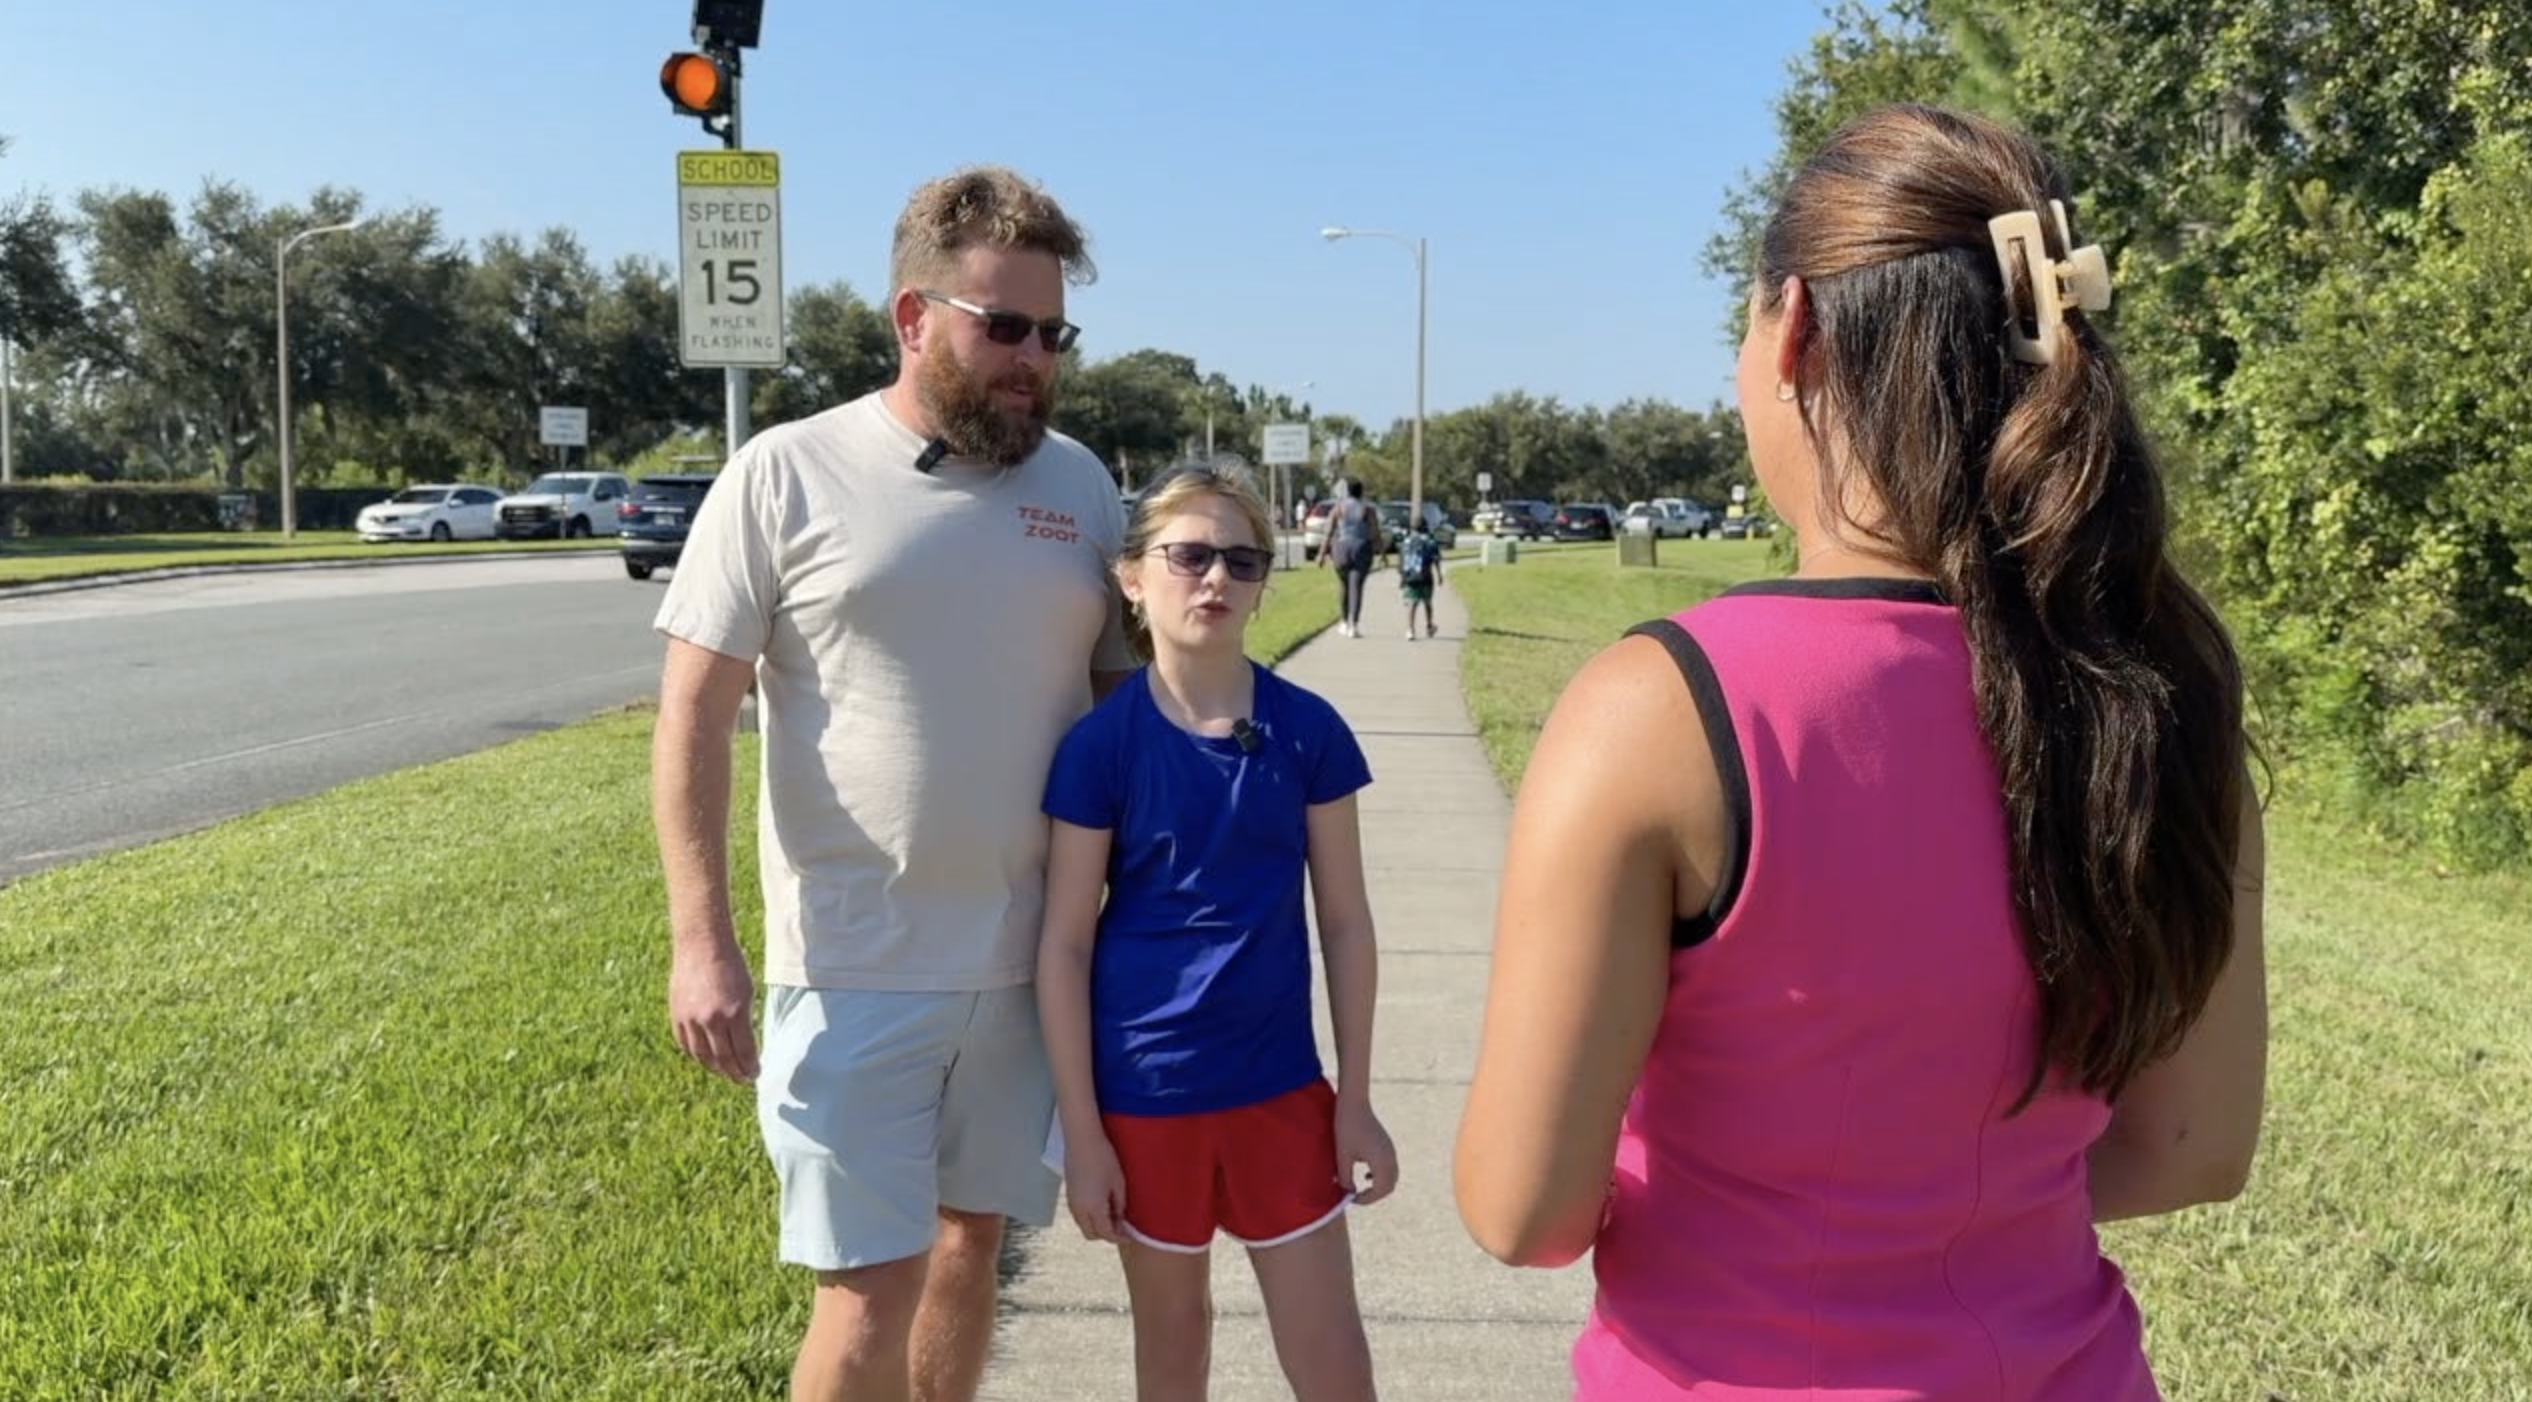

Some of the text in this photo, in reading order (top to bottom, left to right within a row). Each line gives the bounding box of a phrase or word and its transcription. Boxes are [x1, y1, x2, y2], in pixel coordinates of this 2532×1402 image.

[683, 159, 773, 180] SCHOOL
[687, 203, 772, 223] SPEED
[697, 230, 763, 249] LIMIT
[701, 259, 761, 305] 15
[709, 316, 757, 329] WHEN
[691, 335, 775, 349] FLASHING
[1017, 506, 1075, 527] TEAM
